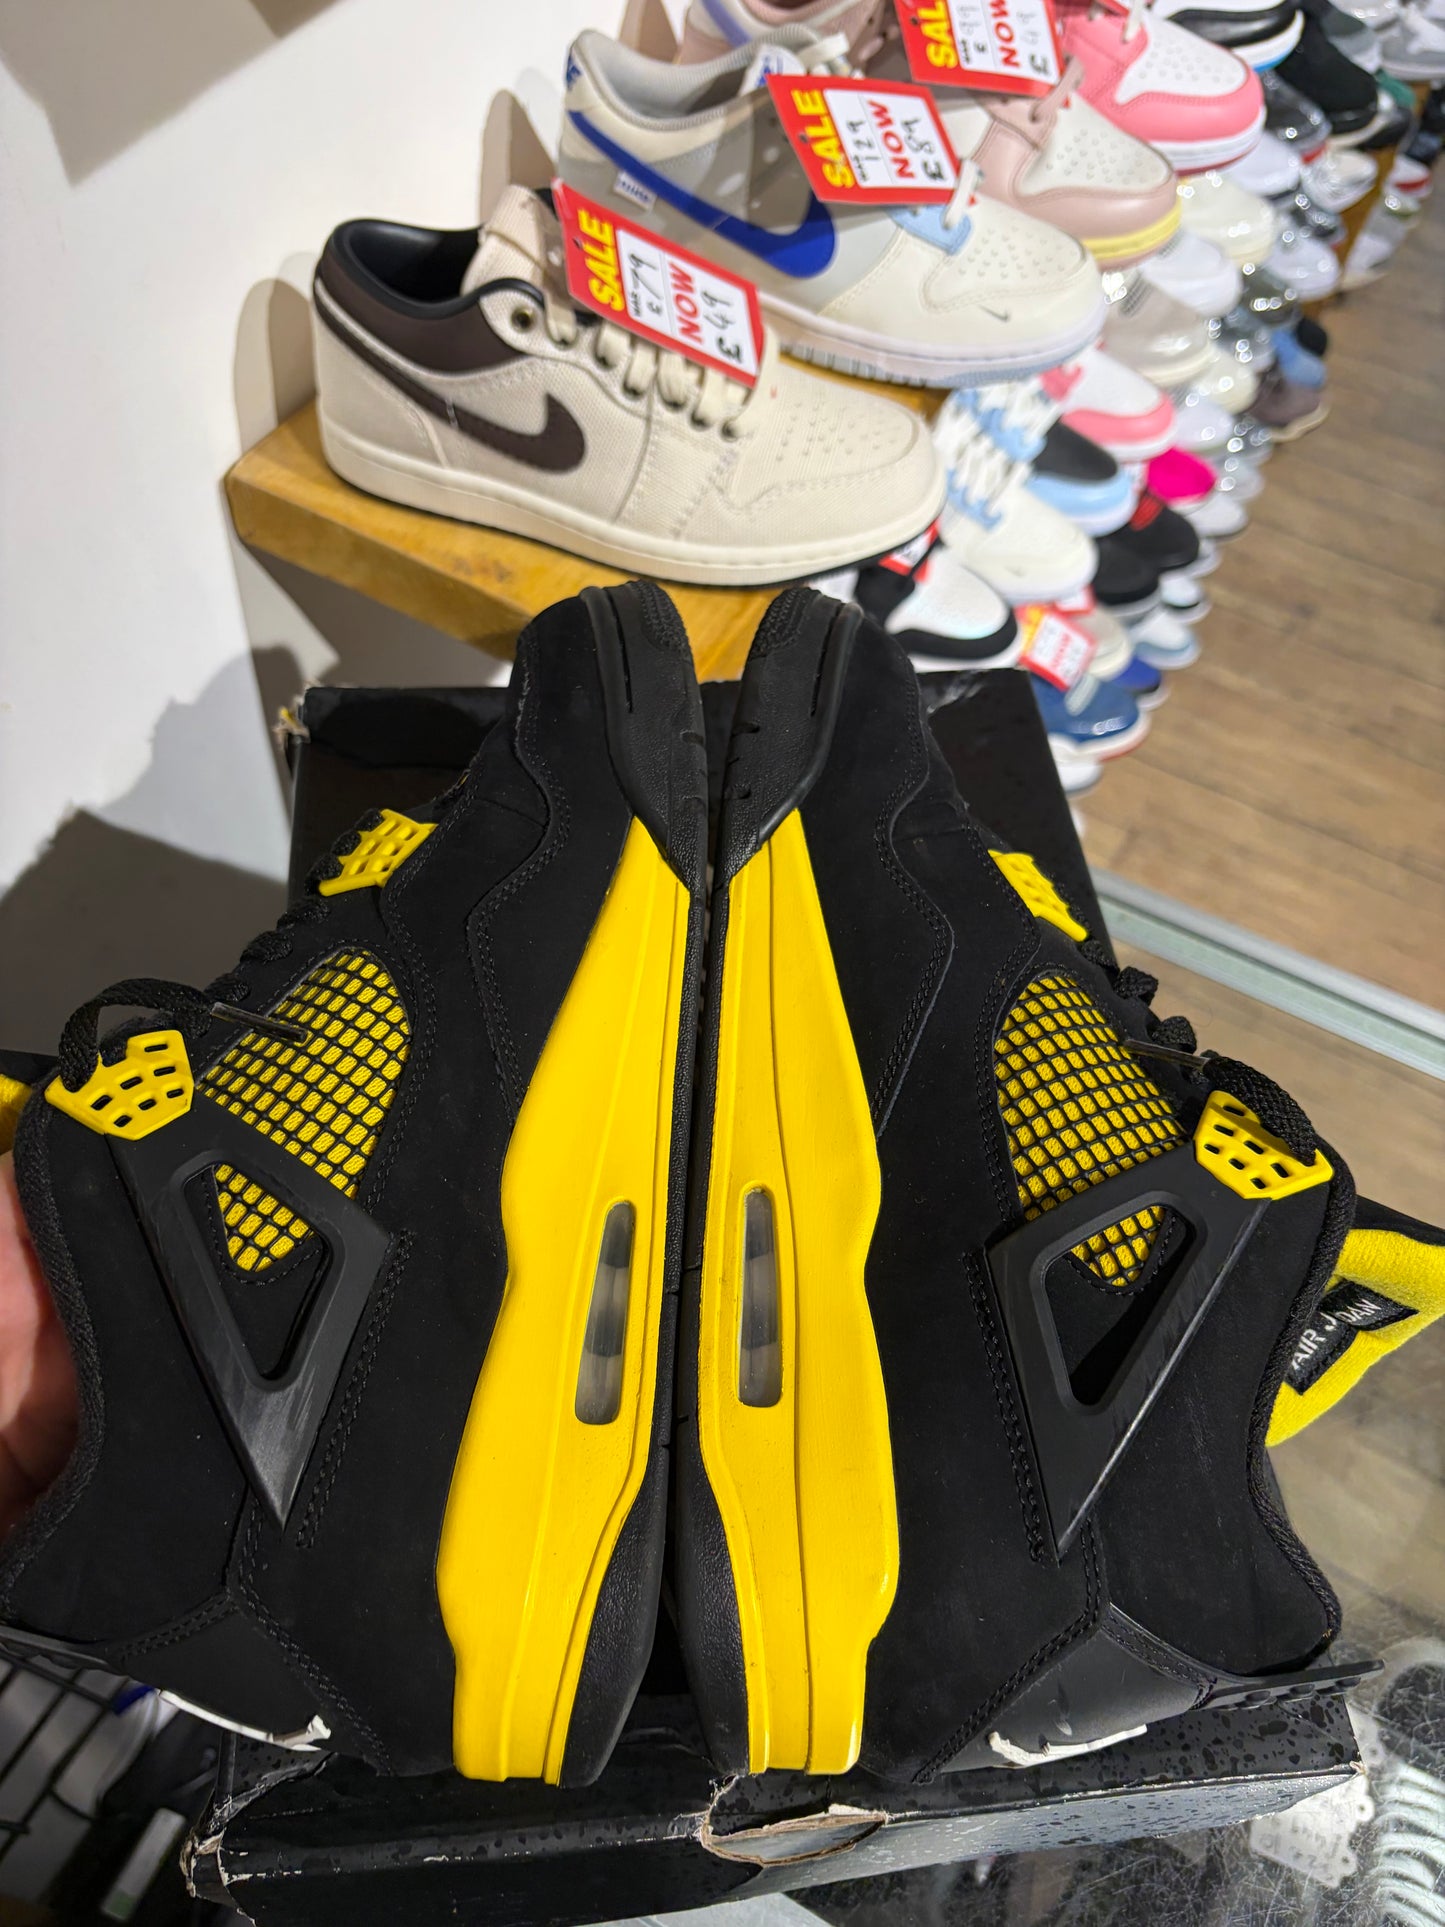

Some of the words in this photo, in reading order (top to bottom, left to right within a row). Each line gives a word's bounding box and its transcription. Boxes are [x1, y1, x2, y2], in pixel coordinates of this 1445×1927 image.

[917, 0, 958, 69] SAL
[989, 0, 1020, 68] NOW
[791, 89, 855, 189] SALE
[867, 99, 916, 179] NOW
[578, 209, 625, 311] SALE
[669, 262, 704, 344] NOW
[1291, 1328, 1327, 1370] AIR
[1320, 1298, 1381, 1332] JDAN
